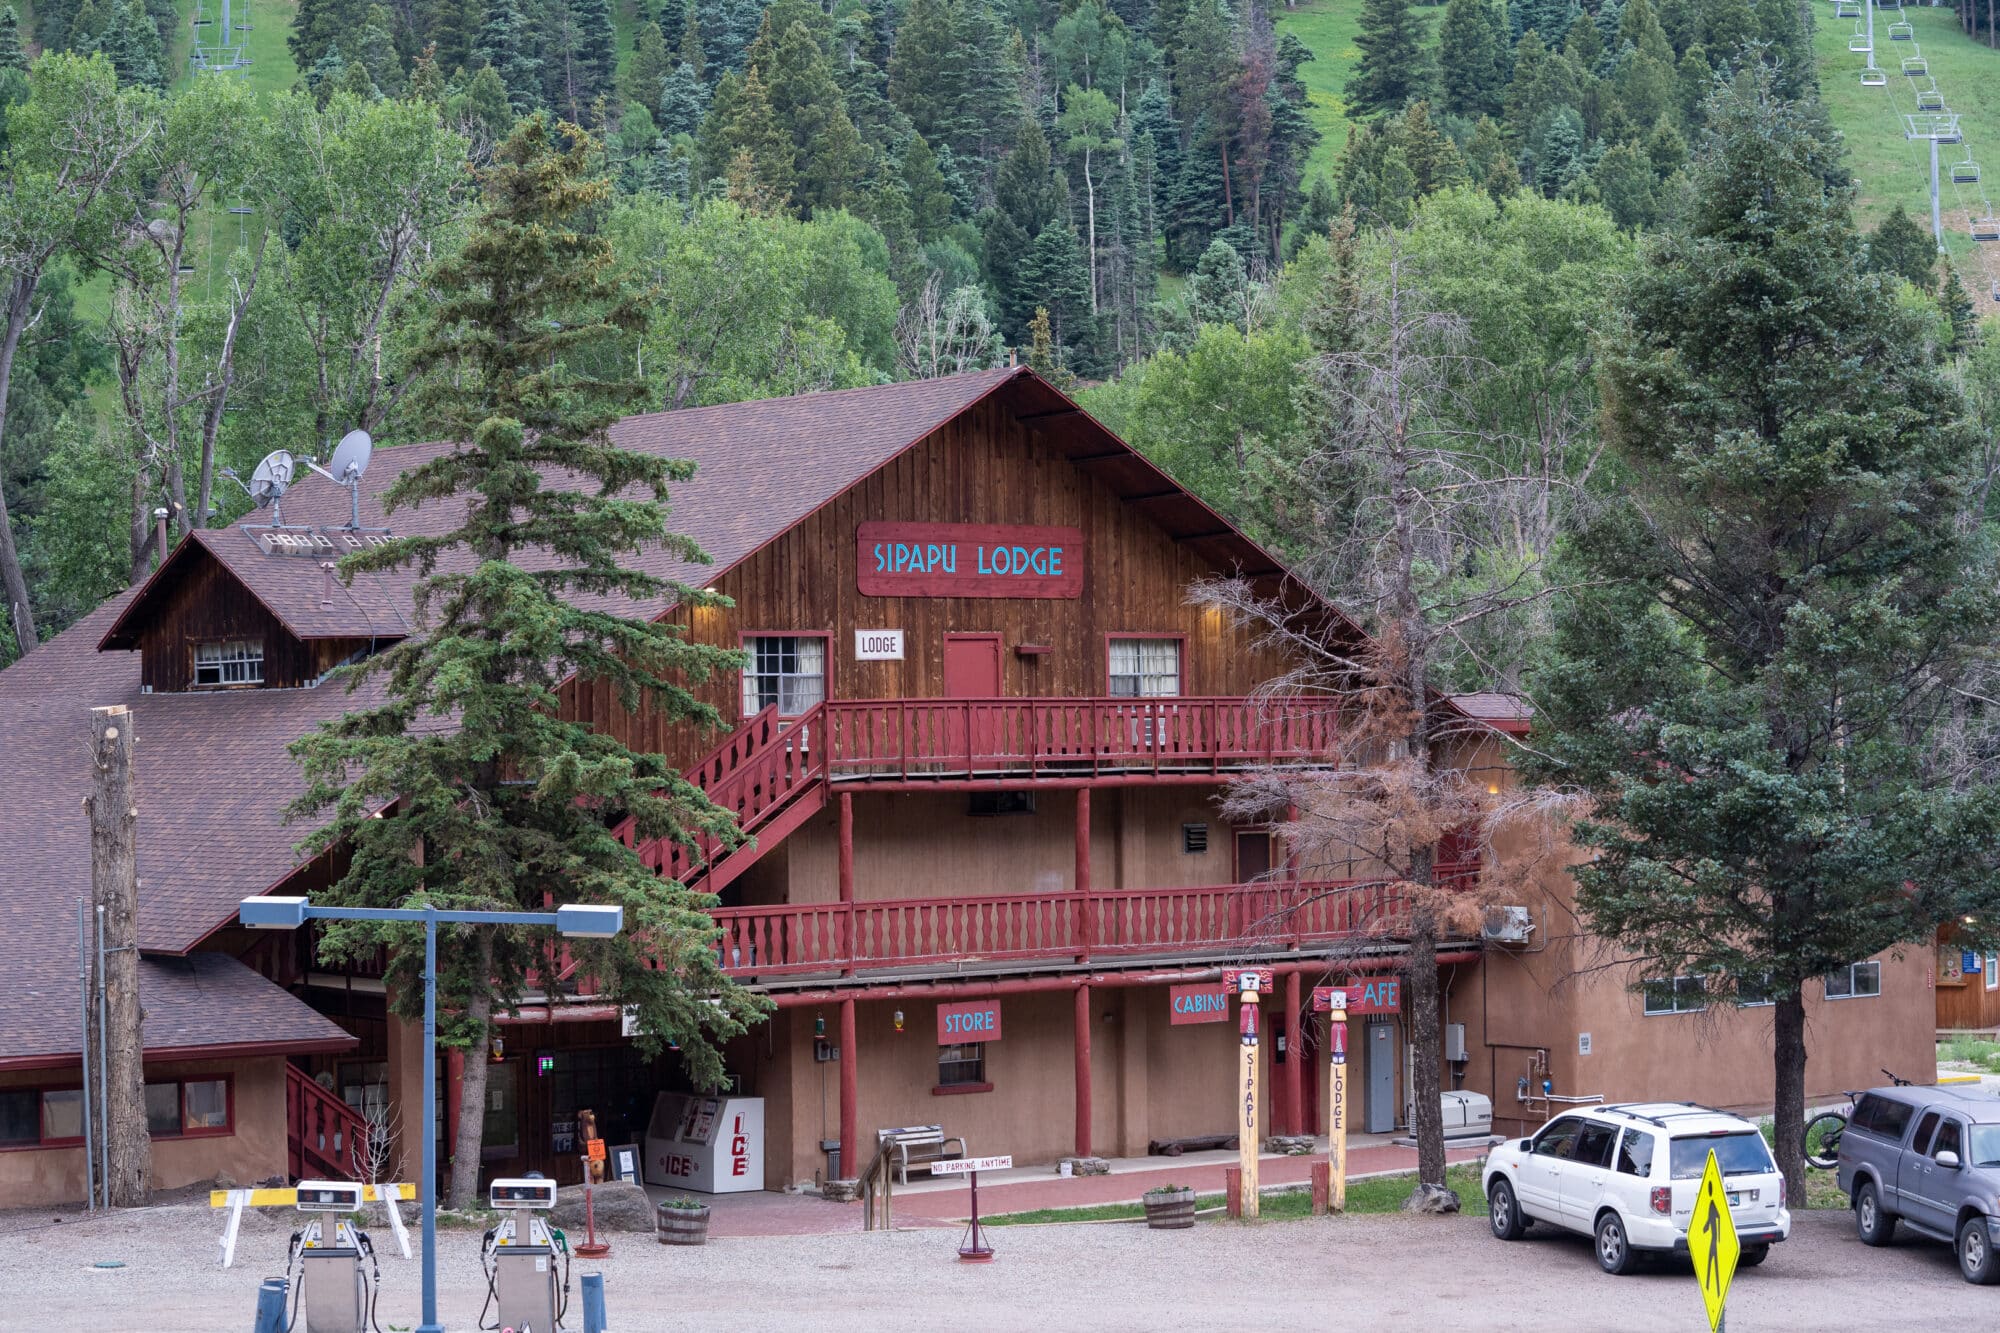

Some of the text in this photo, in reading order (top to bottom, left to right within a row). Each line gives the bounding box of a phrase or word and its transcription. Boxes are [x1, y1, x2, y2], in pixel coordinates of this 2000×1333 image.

[873, 543, 1064, 576] SIPAPU LODGE
[861, 636, 897, 653] LODGE
[1173, 993, 1226, 1014] CABINS
[1354, 983, 1398, 1007] AFE
[945, 1010, 994, 1033] STORE
[1245, 1053, 1254, 1128] SIPAPU
[1334, 1067, 1343, 1129] LODGE
[731, 1112, 750, 1177] ICE
[665, 1152, 692, 1177] ICE
[933, 1157, 1011, 1173] NO PARKING ANYTIME
